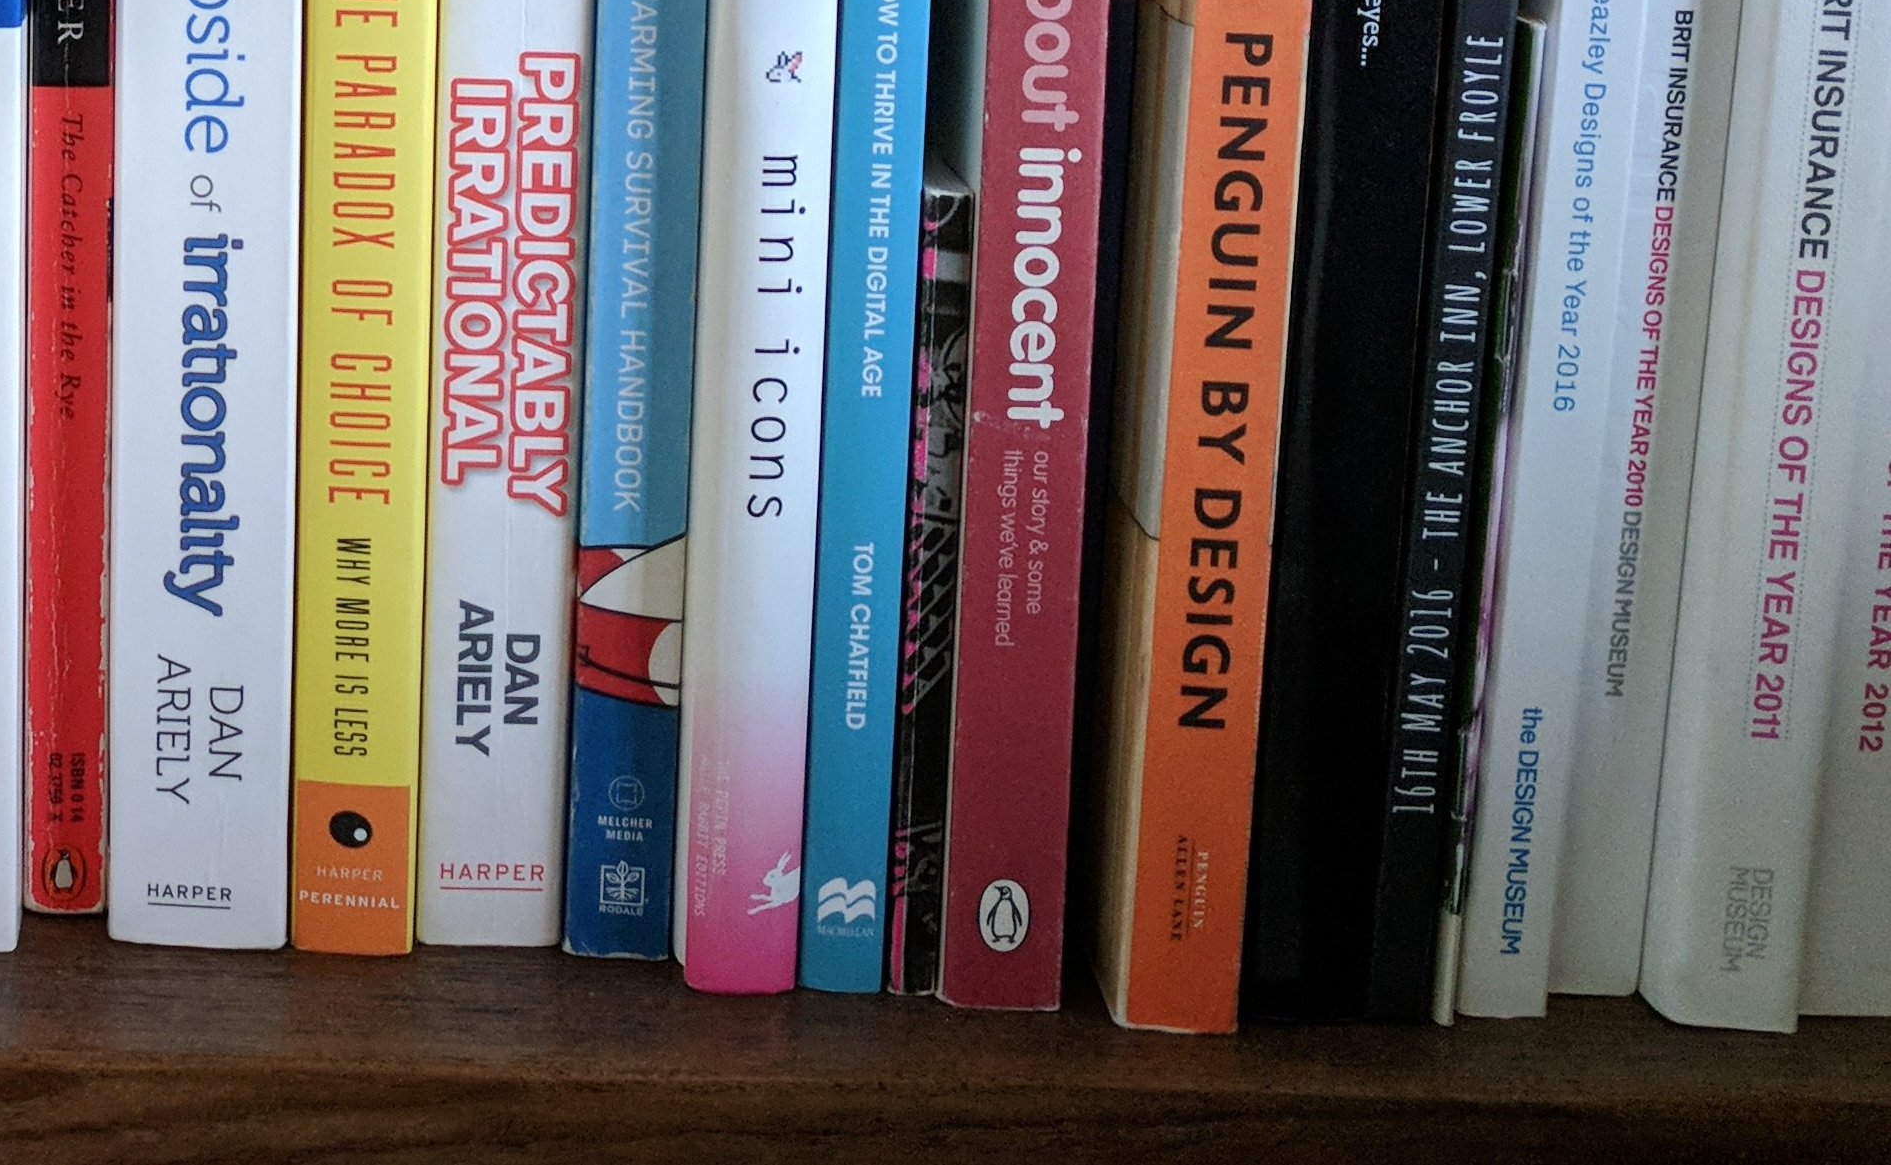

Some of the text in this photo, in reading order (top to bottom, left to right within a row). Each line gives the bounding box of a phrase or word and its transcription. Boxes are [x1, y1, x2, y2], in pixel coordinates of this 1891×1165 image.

[331, 54, 398, 249] PARADOX
[872, 70, 898, 156] THRIVE
[1572, 82, 1607, 190] Designs
[1799, 49, 1849, 260] INSURANCE
[59, 172, 85, 277] Catcher
[620, 150, 654, 319] SURVIVAL
[1203, 32, 1274, 351] PENGUIN
[440, 76, 513, 486] IRRATIONAL
[507, 51, 581, 518] PREDICTABLY
[862, 246, 888, 341] DIGITAL
[1006, 146, 1082, 429] innocent
[1428, 34, 1505, 476] ANCHOR LOWER FROYLE
[1561, 279, 1587, 336] Year
[746, 154, 807, 518] mini icons
[859, 346, 884, 398] AGE
[1553, 343, 1581, 413] 2016
[1604, 9, 1695, 698] BRIT INSURANCE DESIGNS YEAR 2010 MUSEUM
[1781, 269, 1826, 426] DESIGNS
[163, 232, 244, 618] irrationality
[327, 352, 394, 505] CHOICE
[612, 328, 649, 514] HANDBOOK
[336, 537, 372, 586] WHY
[994, 449, 1023, 647] things we've learned
[1025, 449, 1051, 614] our story some
[335, 597, 371, 664] MORE
[846, 542, 875, 731] TOM CHATFIELD
[1758, 570, 1796, 666] YEAR
[155, 653, 192, 805] ARIELY
[455, 599, 494, 757] ARIELY
[503, 633, 541, 726] DAN
[1750, 673, 1786, 740] 2011
[1858, 682, 1888, 753] 2012
[208, 685, 244, 781] DAN
[333, 707, 369, 758] LESS
[316, 865, 384, 881] HARPER
[440, 863, 545, 882] HARPER
[597, 814, 653, 830] MELCHER
[605, 829, 644, 842] MEDIA
[147, 883, 232, 902] HARPER
[298, 889, 400, 910] PERENNIAL
[1499, 847, 1531, 956] MUSEUM
